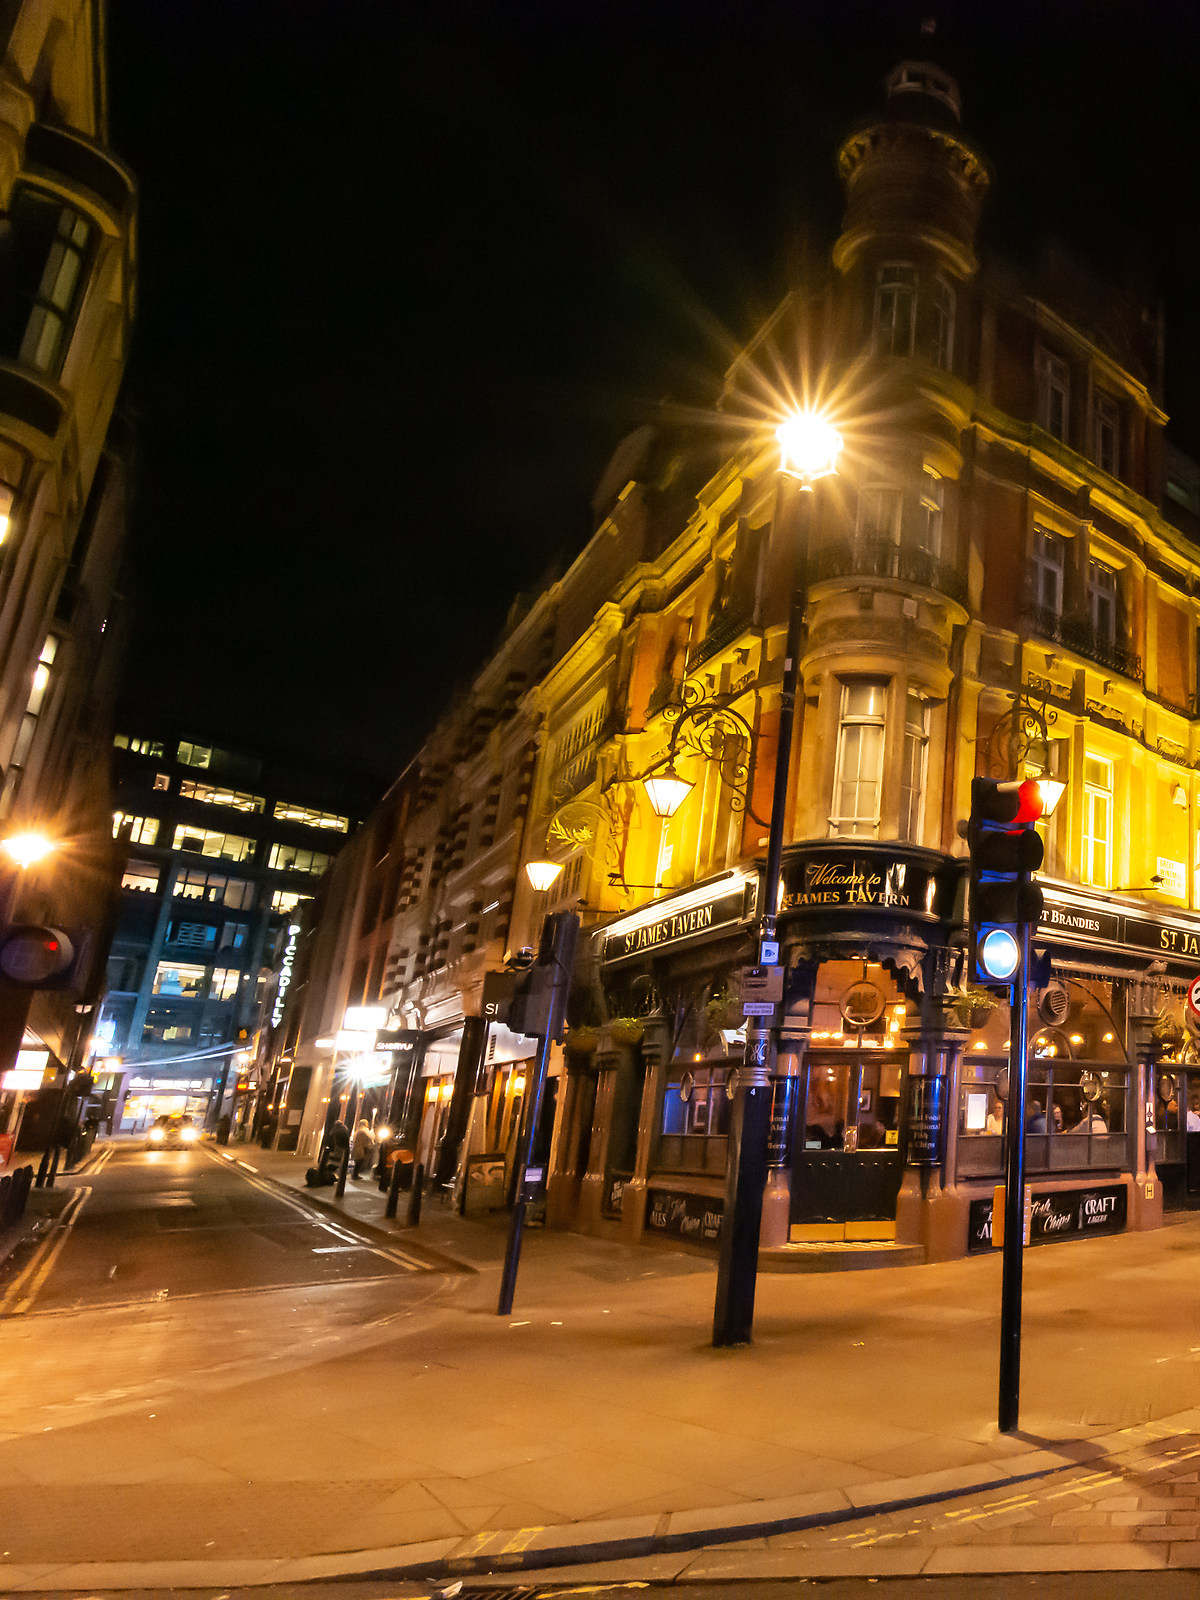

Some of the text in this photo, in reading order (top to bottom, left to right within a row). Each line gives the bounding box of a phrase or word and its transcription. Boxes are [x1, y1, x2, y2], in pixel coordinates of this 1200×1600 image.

[806, 863, 882, 886] Welcome to
[795, 892, 840, 904] JAMES
[845, 890, 909, 906] TAVERN
[636, 921, 669, 949] JAMES
[671, 905, 713, 937] TAVERN
[1051, 910, 1100, 932] BRANDIES
[271, 924, 301, 1028] PICCADILLY
[1085, 1196, 1117, 1215] CRAFT
[1043, 1213, 1071, 1232] Chips
